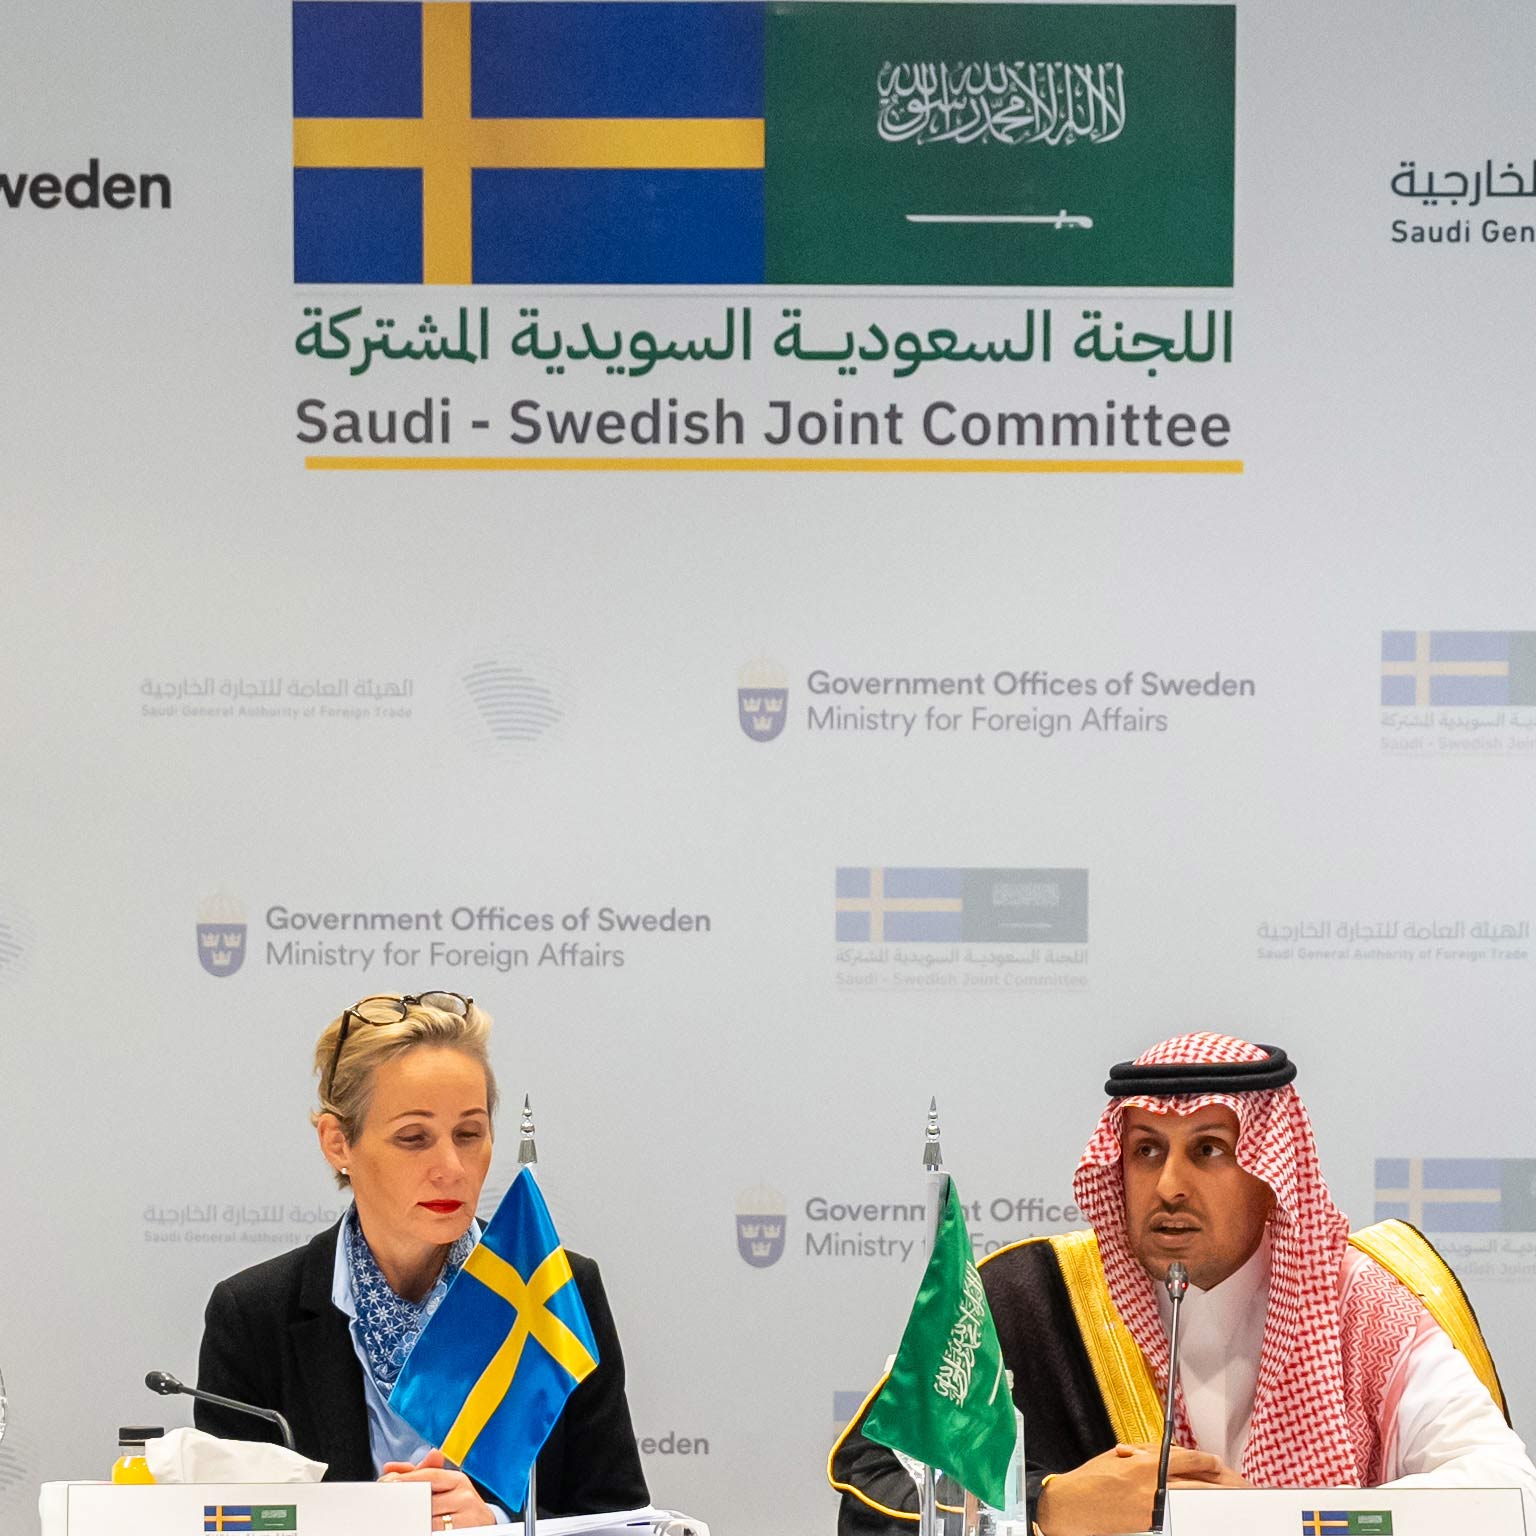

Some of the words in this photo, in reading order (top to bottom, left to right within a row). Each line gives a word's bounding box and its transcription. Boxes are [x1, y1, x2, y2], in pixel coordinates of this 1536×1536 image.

[1391, 219, 1471, 244] Saudi
[294, 306, 489, 377] المشتركة
[510, 307, 752, 378] السويدية
[1073, 309, 1233, 378] اللجنة
[296, 397, 450, 445] Saudi
[510, 397, 744, 446] Swedish
[764, 398, 904, 446] Joint
[922, 399, 1231, 448] Committee
[806, 669, 985, 696] Government
[993, 670, 1098, 696] Offices
[1104, 671, 1134, 697] of
[1141, 671, 1256, 697] Sweden
[807, 705, 917, 738] Ministry
[924, 705, 963, 732] for
[971, 706, 1072, 739] Foreign
[1080, 706, 1168, 733] Affairs
[265, 905, 443, 932] Government
[450, 906, 555, 932] Offices
[561, 906, 590, 932] of
[597, 906, 711, 933] Sweden
[266, 940, 376, 972] Ministry
[382, 941, 421, 967] for
[429, 941, 529, 974] Foreign
[537, 941, 625, 968] Affairs
[804, 1231, 915, 1263] Ministry
[637, 1430, 711, 1456] eden
